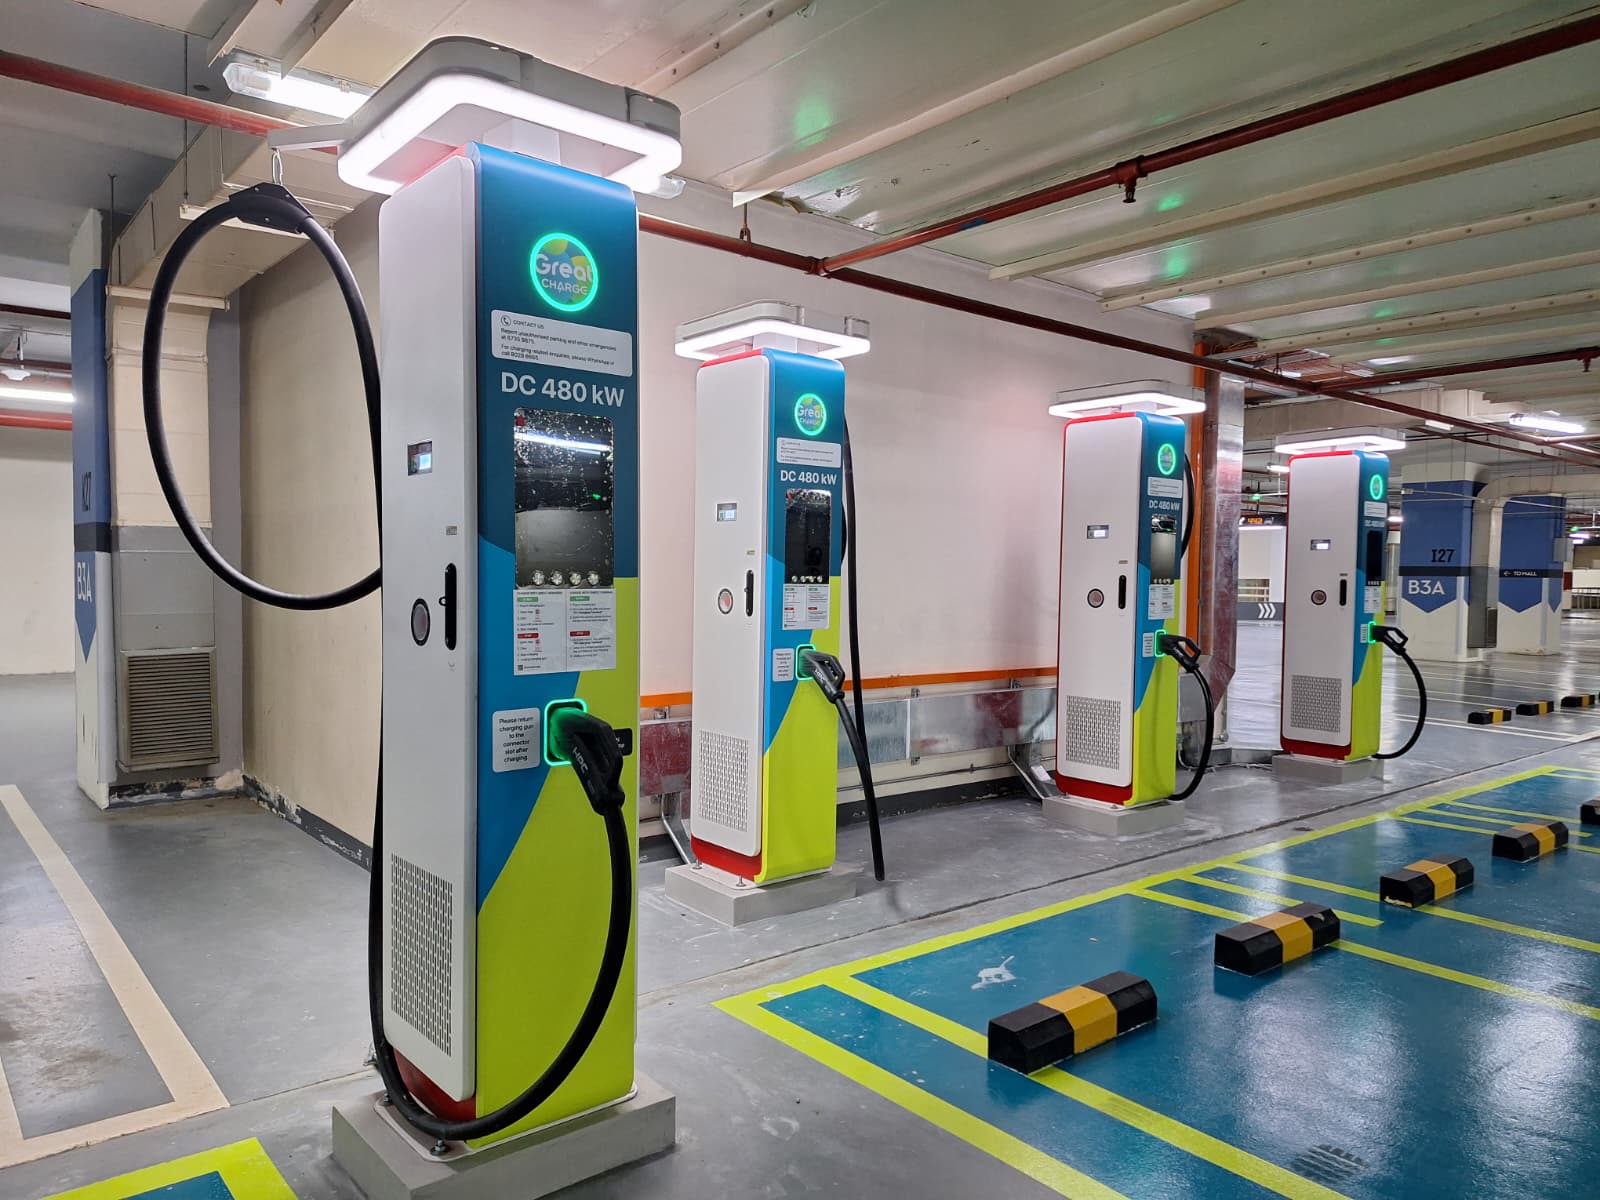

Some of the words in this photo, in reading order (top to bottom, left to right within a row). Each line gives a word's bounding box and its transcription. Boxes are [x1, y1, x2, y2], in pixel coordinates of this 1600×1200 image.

[535, 253, 593, 282] Great
[541, 278, 588, 296] CHARGE
[501, 371, 536, 396] DC
[542, 378, 587, 403] 480
[592, 384, 624, 407] kW
[780, 469, 796, 482] DC
[798, 471, 819, 484] 480
[821, 473, 837, 485] kW
[1149, 499, 1158, 509] DC
[1431, 549, 1455, 563] I27
[77, 561, 92, 603] B3A
[1408, 580, 1445, 595] B3A
[503, 739, 529, 747] connector
